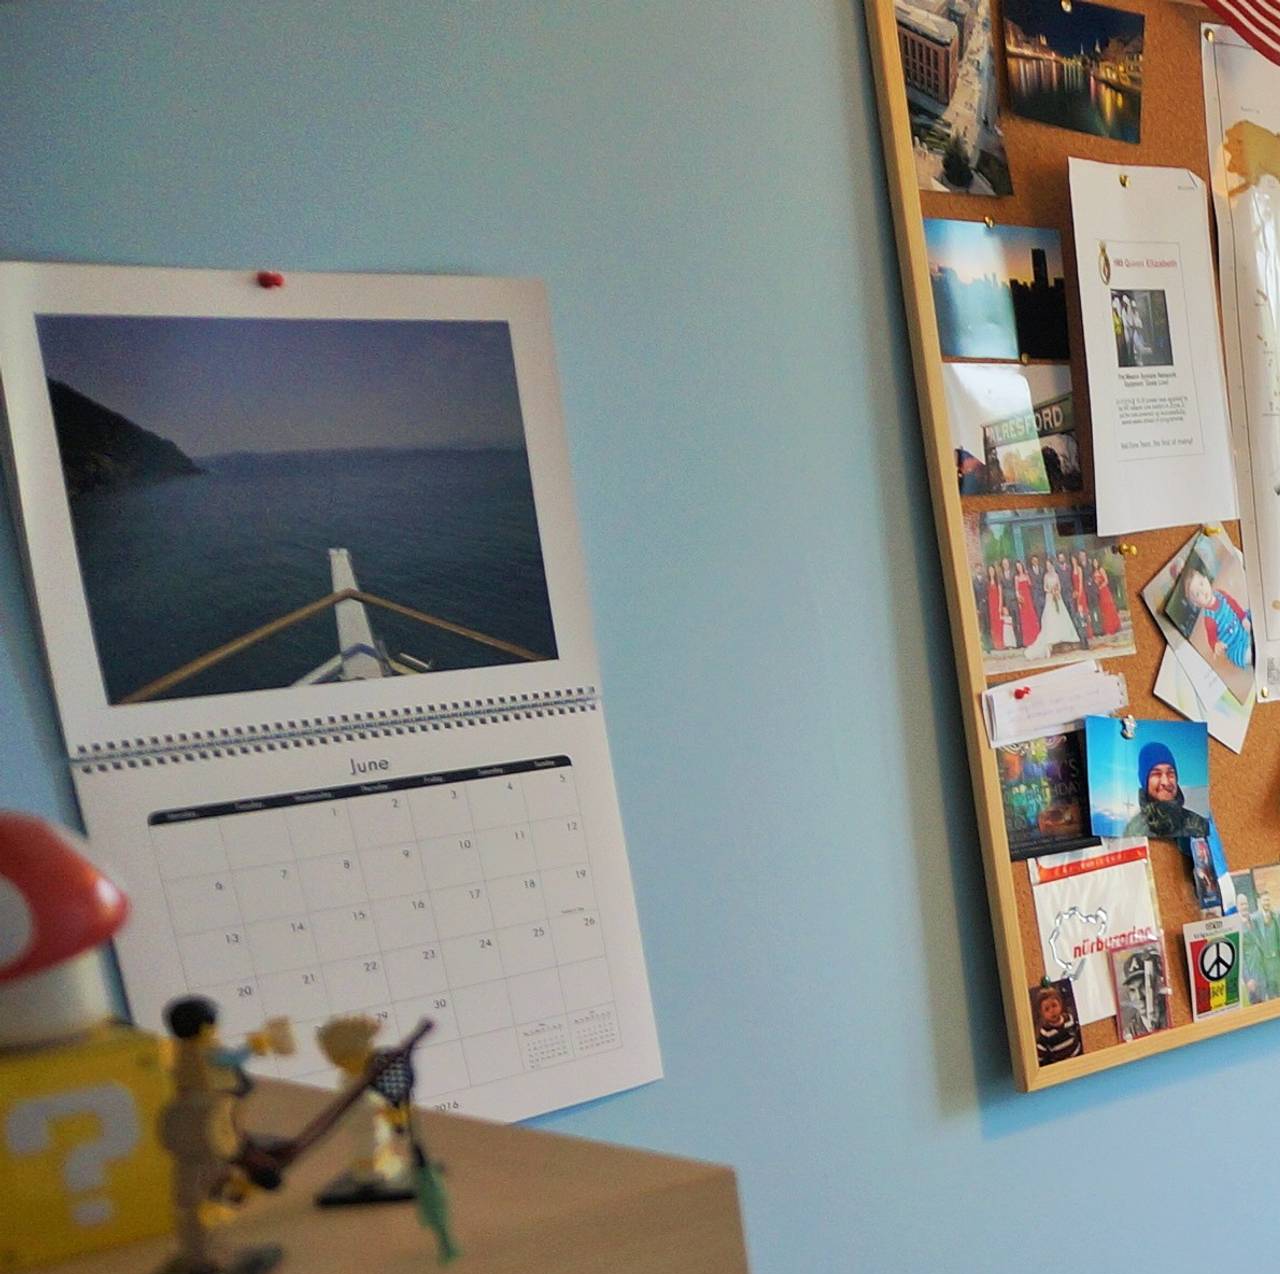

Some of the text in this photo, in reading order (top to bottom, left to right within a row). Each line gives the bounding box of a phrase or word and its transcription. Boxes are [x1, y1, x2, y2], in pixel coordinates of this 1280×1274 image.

[350, 757, 390, 776] June
[391, 799, 399, 808] 2
[451, 790, 457, 799] 3
[507, 782, 513, 791] 4
[559, 774, 566, 783] 5
[215, 822, 578, 890] 6 7 8 9 10 11 12
[225, 869, 587, 943] 13 14 15 16 17 18 19
[238, 917, 595, 997] 20 21 22 23 24 25 26
[433, 999, 446, 1009] 30
